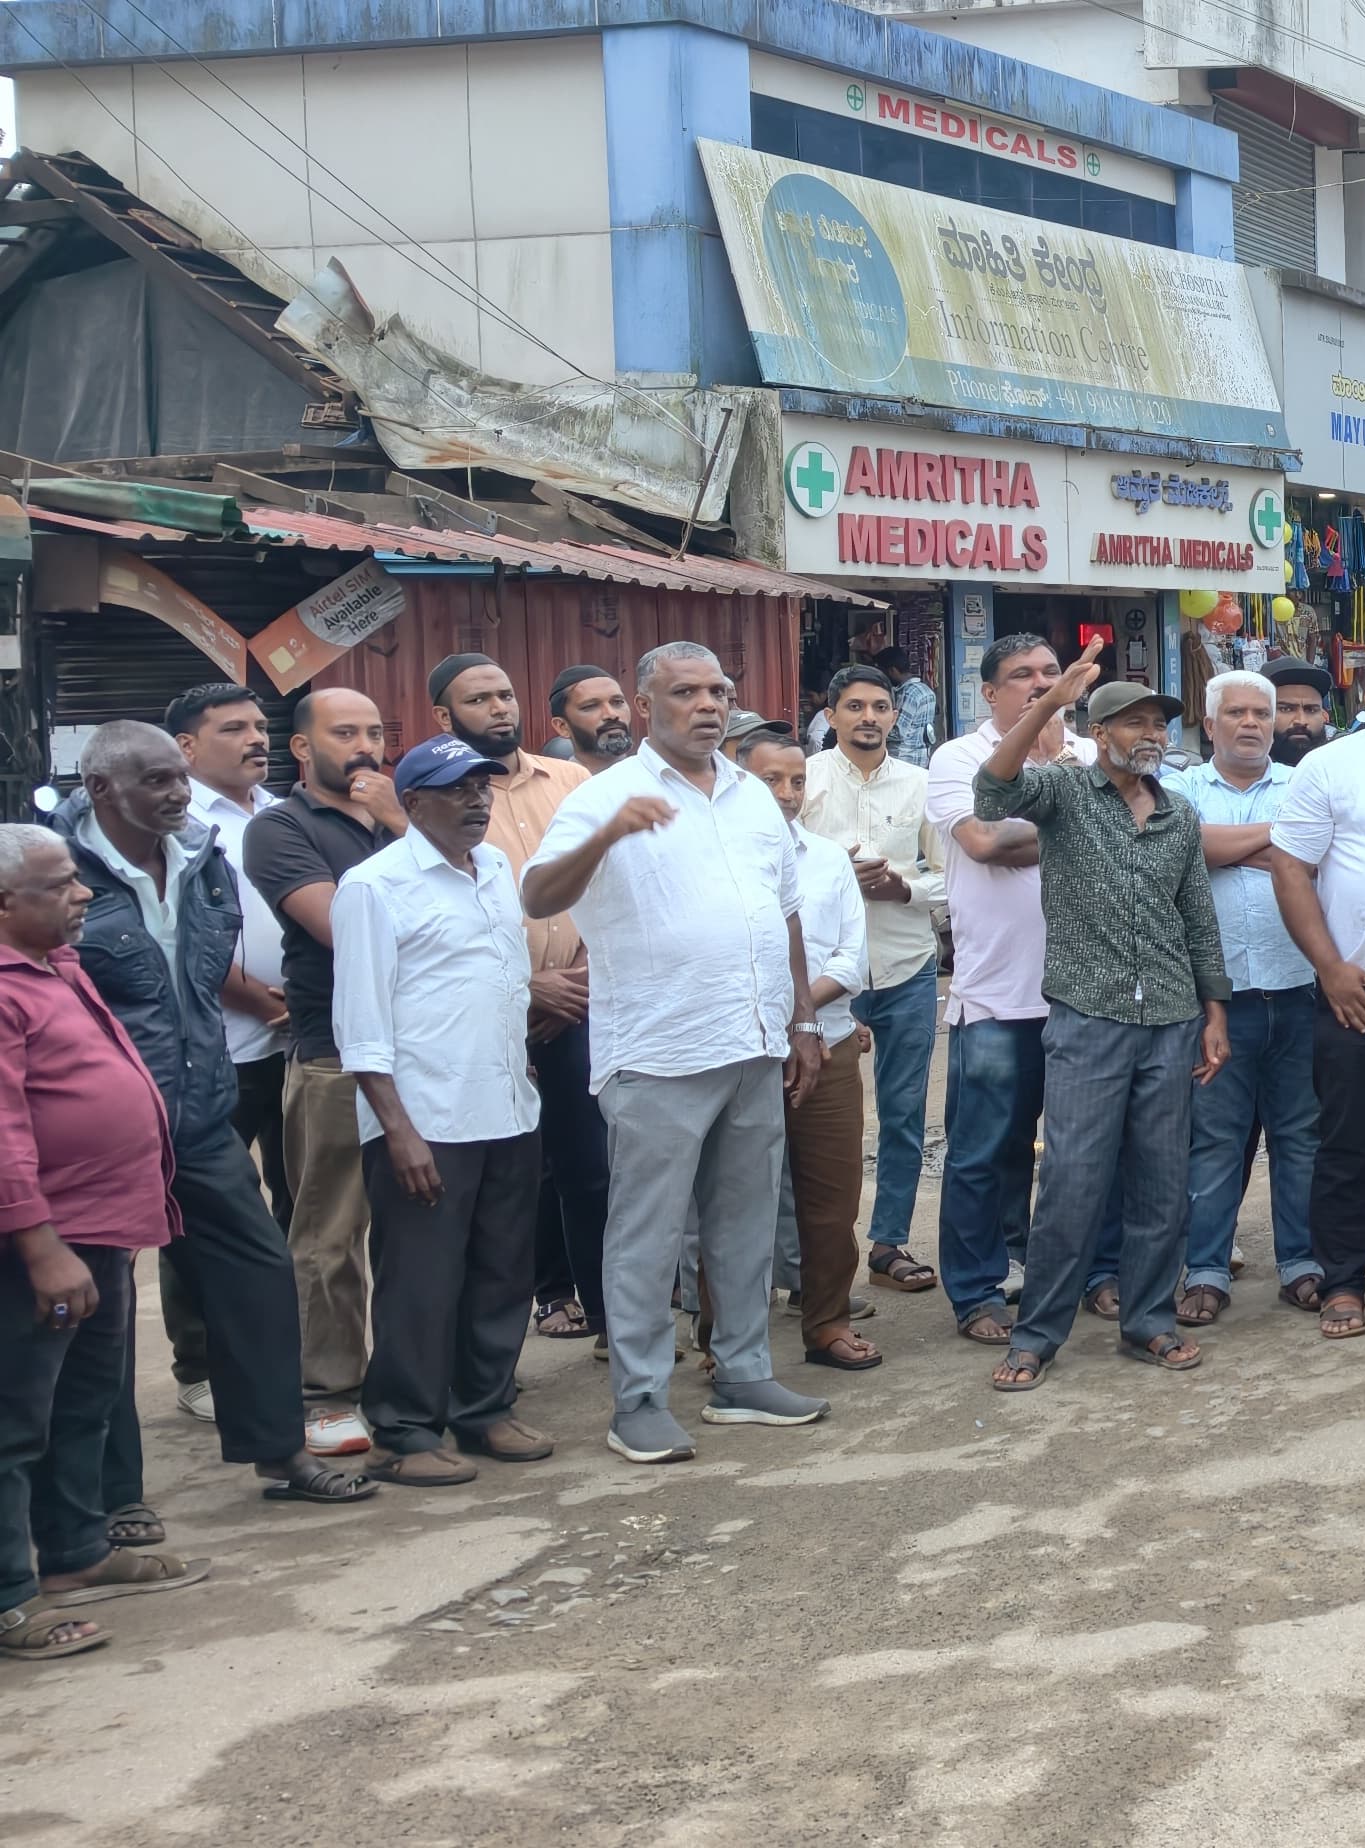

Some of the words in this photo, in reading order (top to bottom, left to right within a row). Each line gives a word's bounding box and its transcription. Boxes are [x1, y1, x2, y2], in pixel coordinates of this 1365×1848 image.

[878, 92, 1077, 168] MEDICALS
[938, 216, 1026, 282] ಮಾಹಿತಿ
[1031, 236, 1107, 314] ಕೇಂದ್ರ
[937, 299, 1077, 361] Information
[1080, 324, 1150, 371] Centre
[844, 446, 1040, 509] AMRITHA
[838, 512, 1049, 572] MEDICALS
[1092, 533, 1173, 566] AMRITHA
[1177, 538, 1254, 571] MEDICALS
[310, 584, 350, 618] Airtel
[348, 568, 373, 594] SIM
[324, 583, 383, 630] Available
[350, 609, 380, 636] Here
